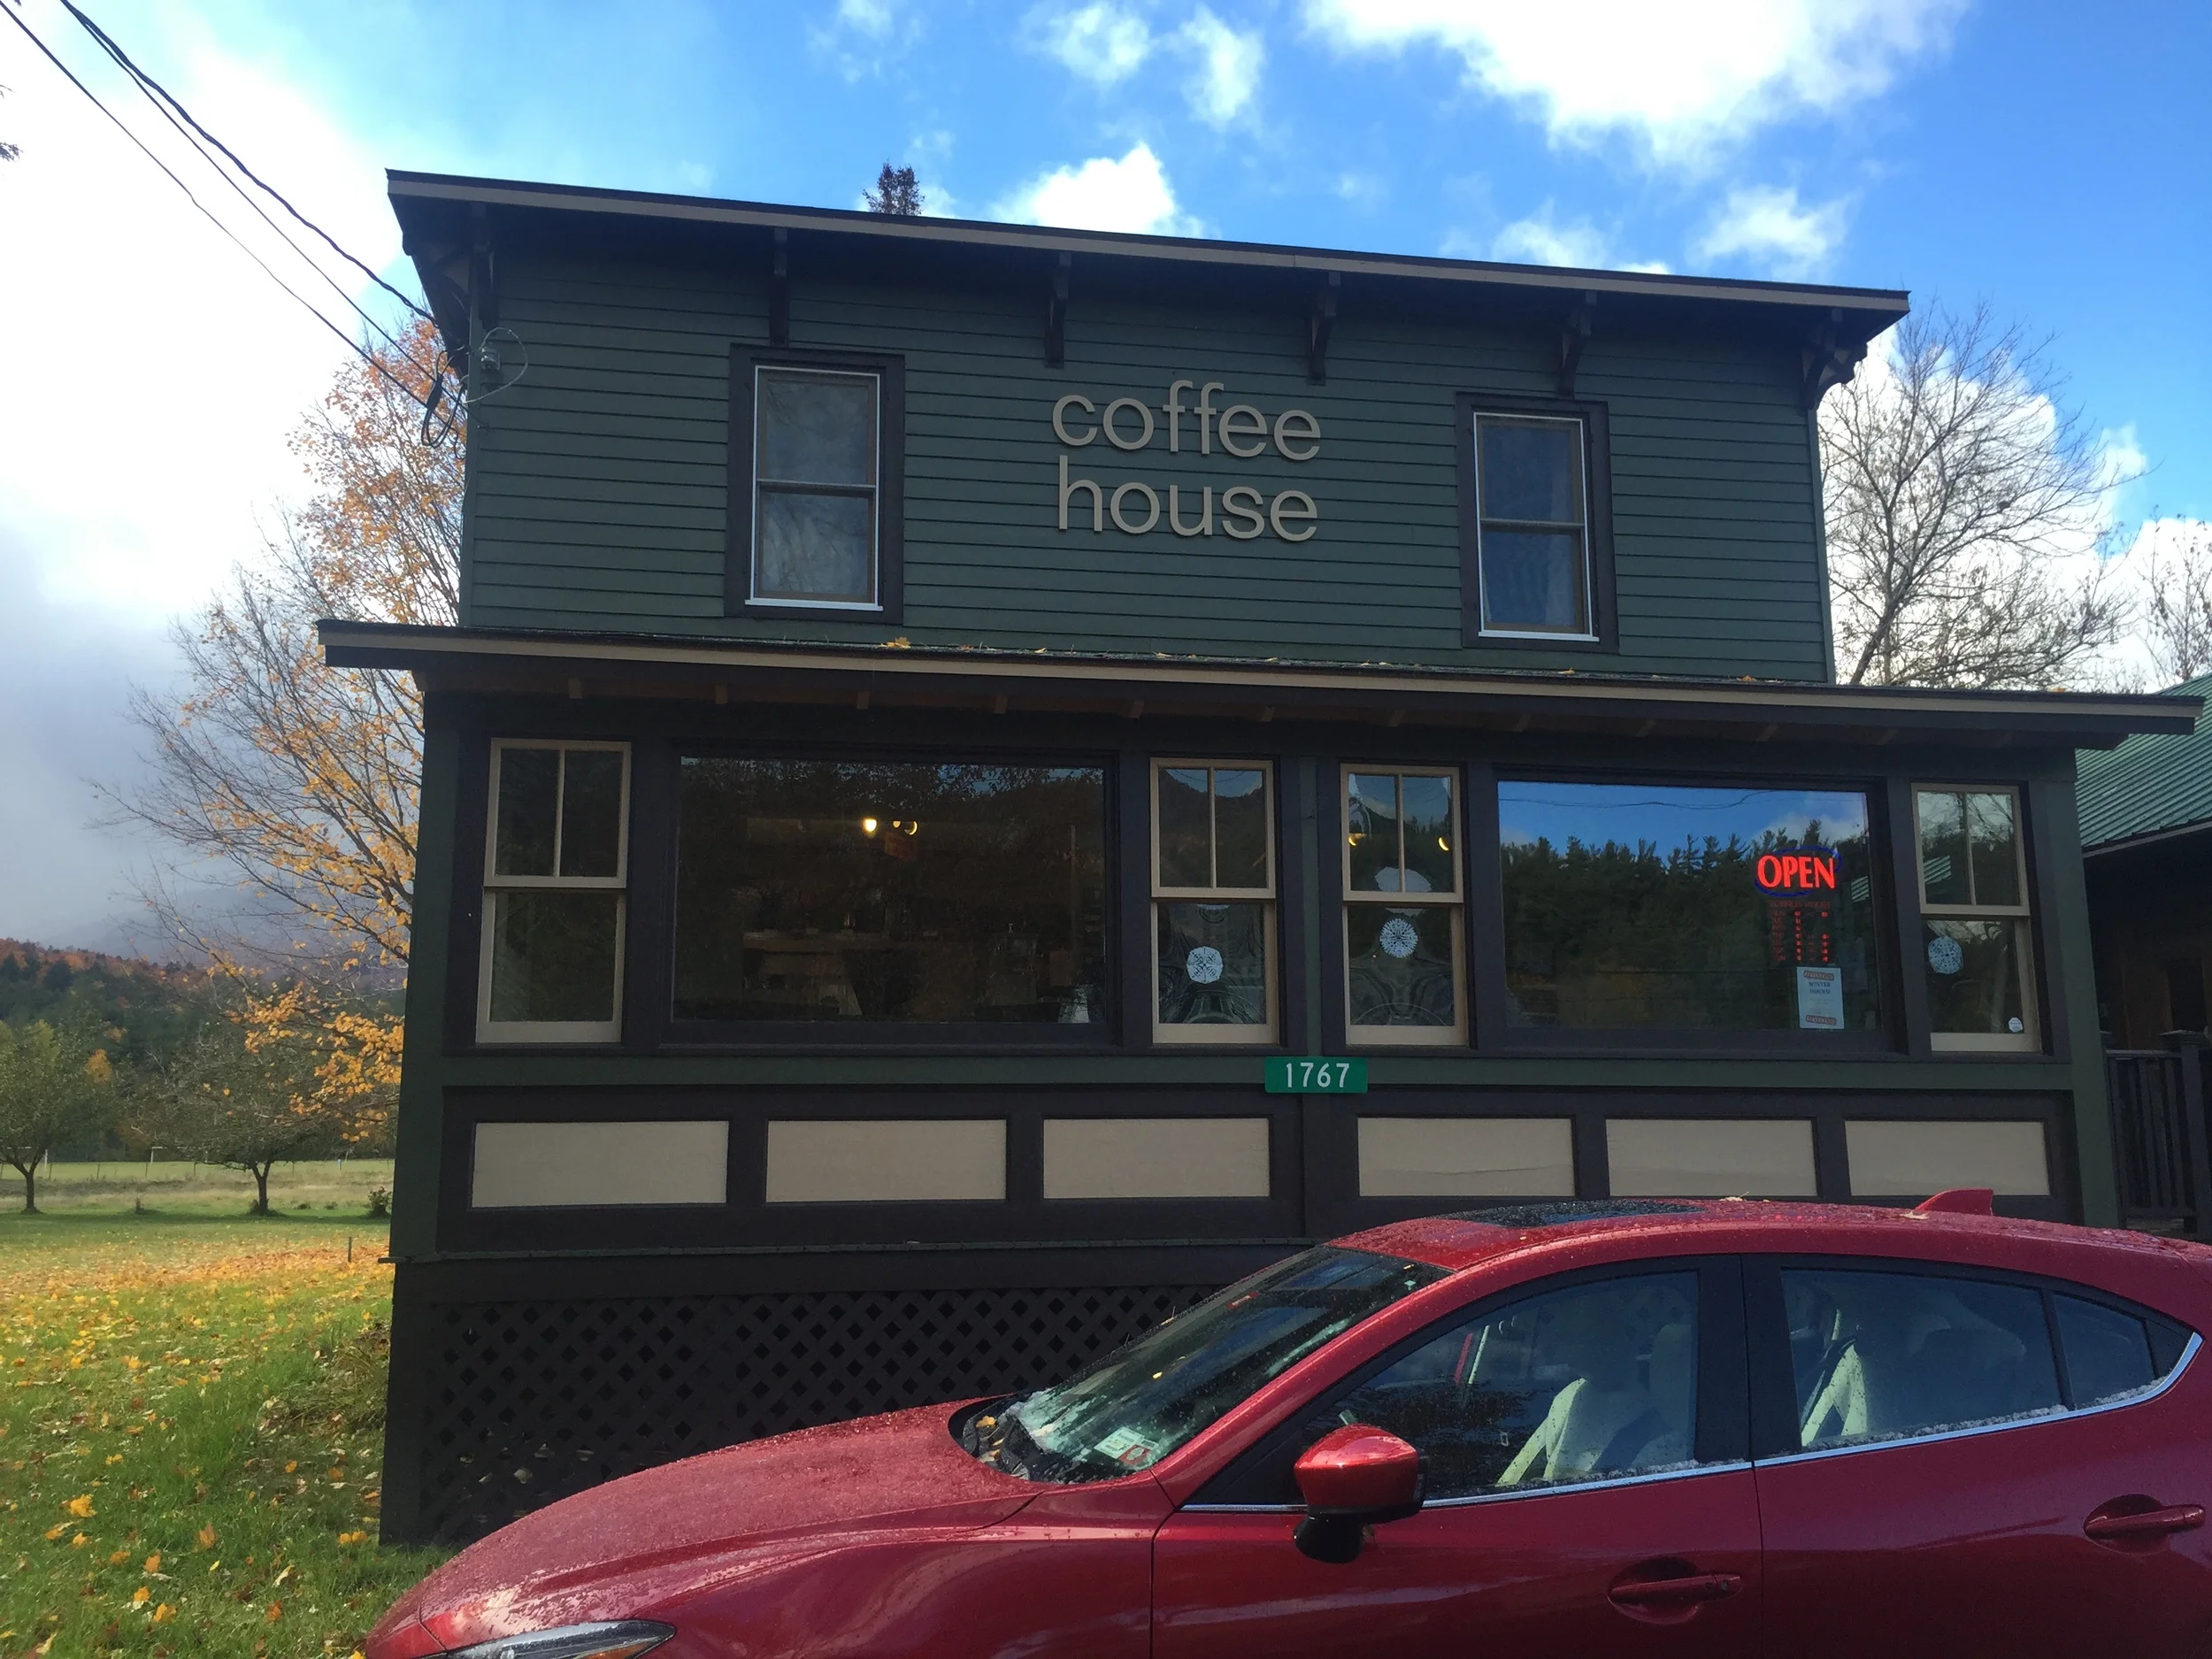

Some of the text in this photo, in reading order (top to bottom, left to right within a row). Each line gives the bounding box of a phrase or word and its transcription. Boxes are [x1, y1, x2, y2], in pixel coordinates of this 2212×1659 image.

[1052, 380, 1321, 461] coffee
[1058, 455, 1318, 541] house
[1757, 855, 1835, 888] OPEN
[1286, 1062, 1349, 1087] 1767
